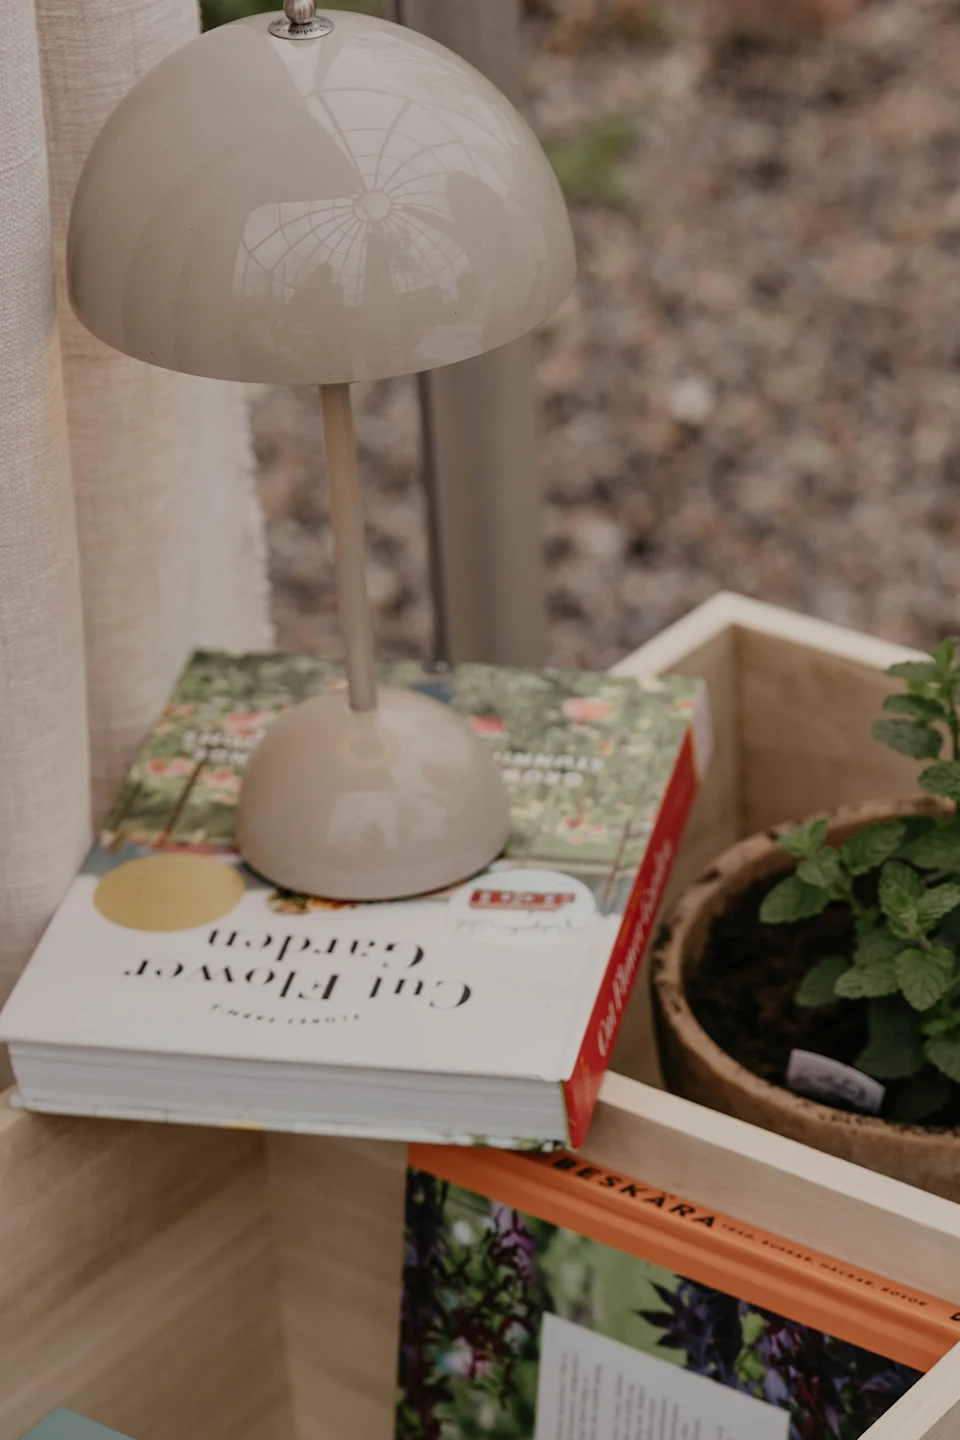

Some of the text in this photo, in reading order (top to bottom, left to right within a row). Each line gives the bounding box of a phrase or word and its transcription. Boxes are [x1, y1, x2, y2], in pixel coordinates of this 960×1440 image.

[206, 928, 425, 969] Garden
[123, 958, 473, 1009] Cut Flower
[552, 1156, 717, 1229] BESKÄRA
